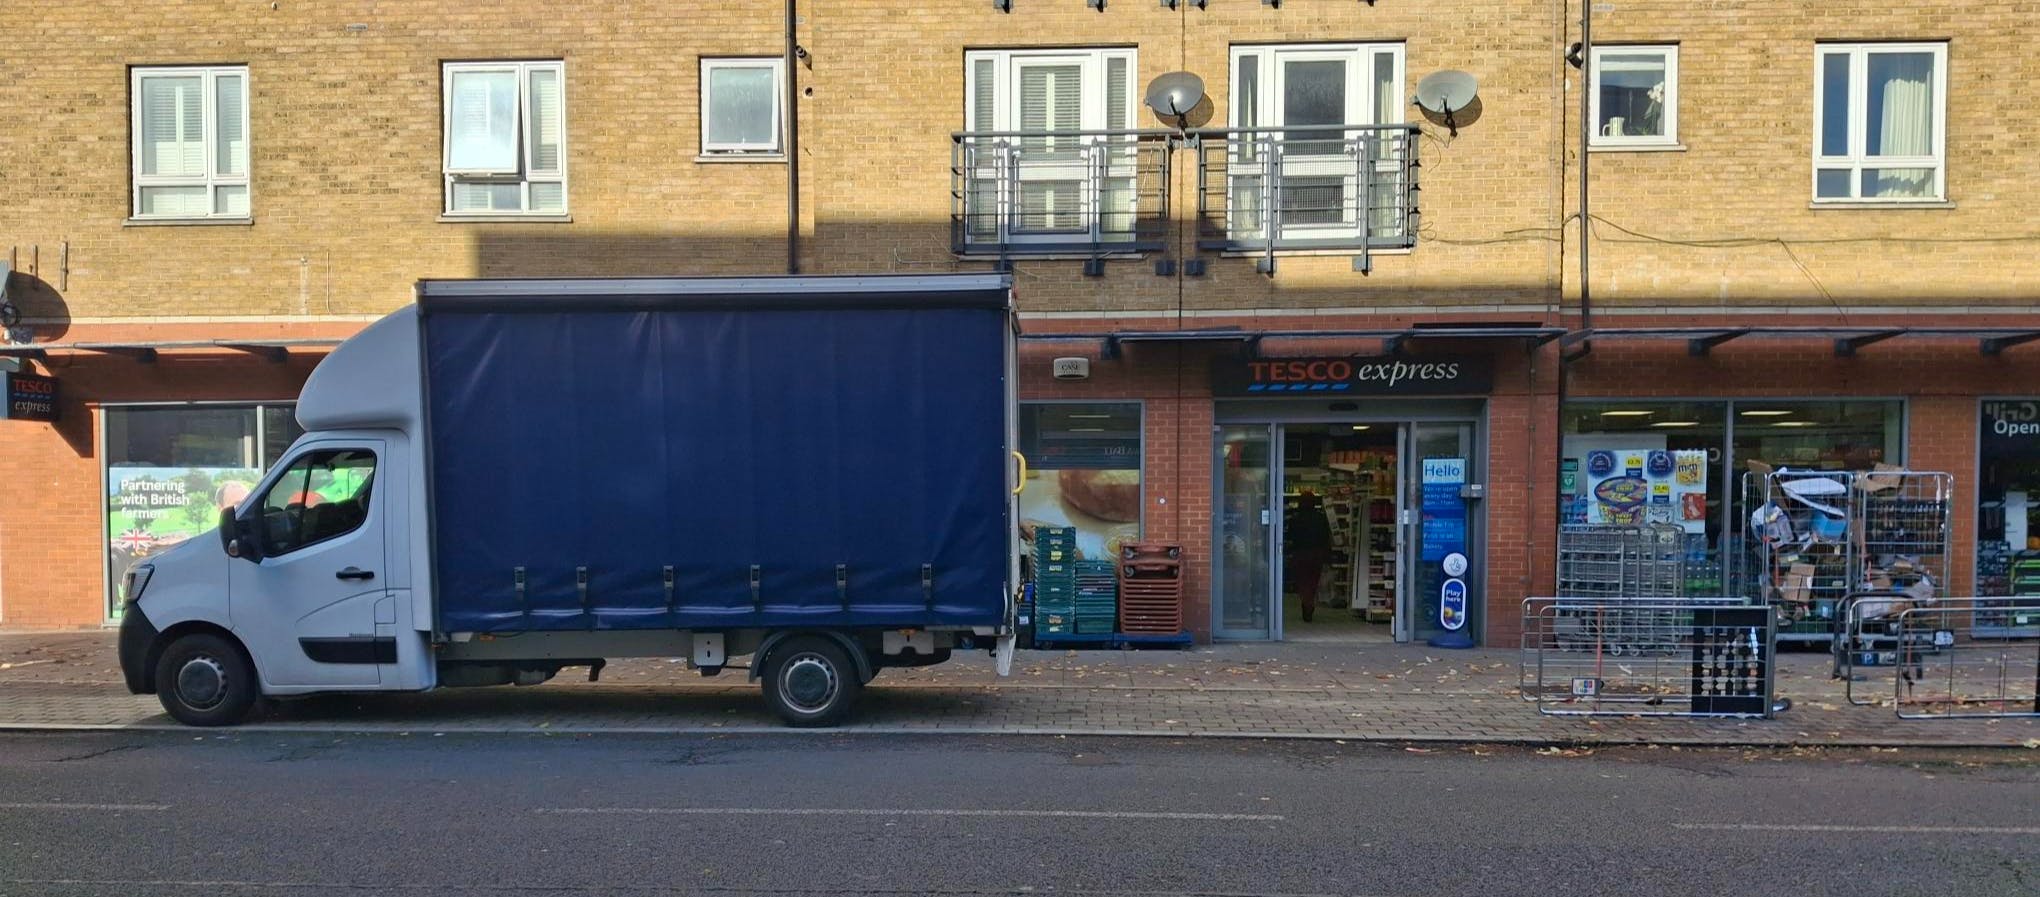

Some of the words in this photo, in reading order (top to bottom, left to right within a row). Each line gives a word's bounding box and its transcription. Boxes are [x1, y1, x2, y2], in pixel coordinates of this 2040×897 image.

[1248, 361, 1349, 381] TESCO
[1358, 361, 1459, 387] express
[15, 380, 53, 394] TESCO
[15, 401, 51, 415] express
[1994, 420, 2040, 437] Open
[1424, 464, 1460, 477] Hello
[121, 479, 185, 494] Partnering
[121, 493, 147, 505] with
[150, 493, 190, 505] British
[121, 507, 169, 519] farmers
[1445, 589, 1462, 598] Play
